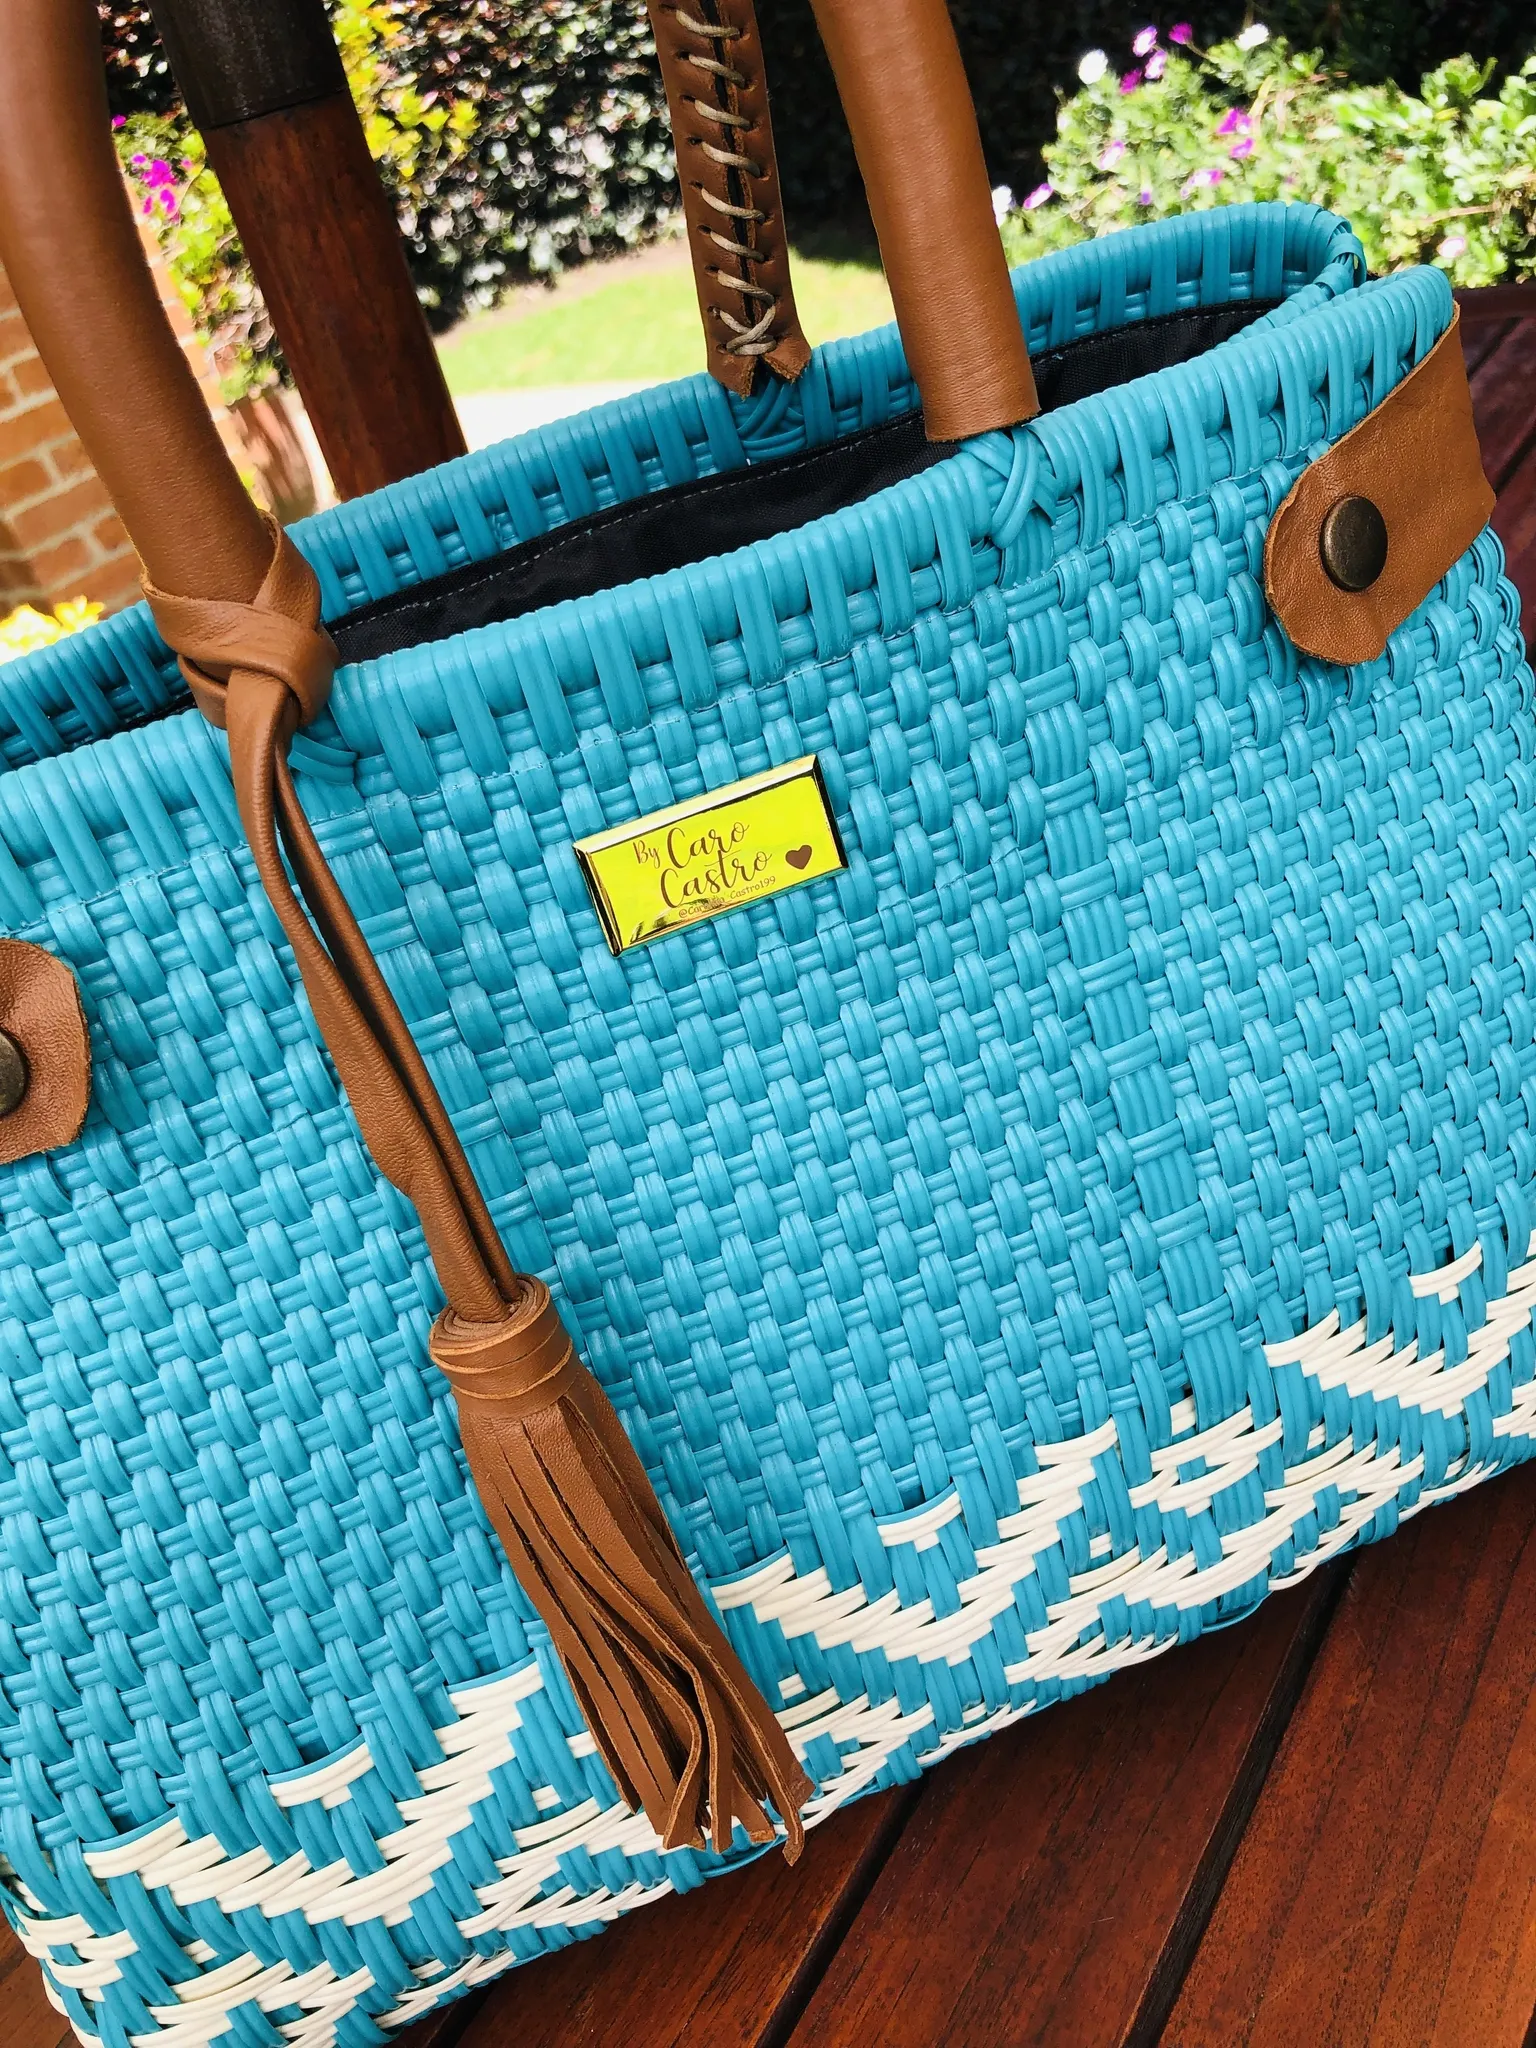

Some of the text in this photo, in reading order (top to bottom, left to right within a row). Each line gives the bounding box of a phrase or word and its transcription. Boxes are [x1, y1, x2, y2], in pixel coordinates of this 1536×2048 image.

[632, 821, 750, 869] By Caro
[660, 849, 773, 908] Castro
